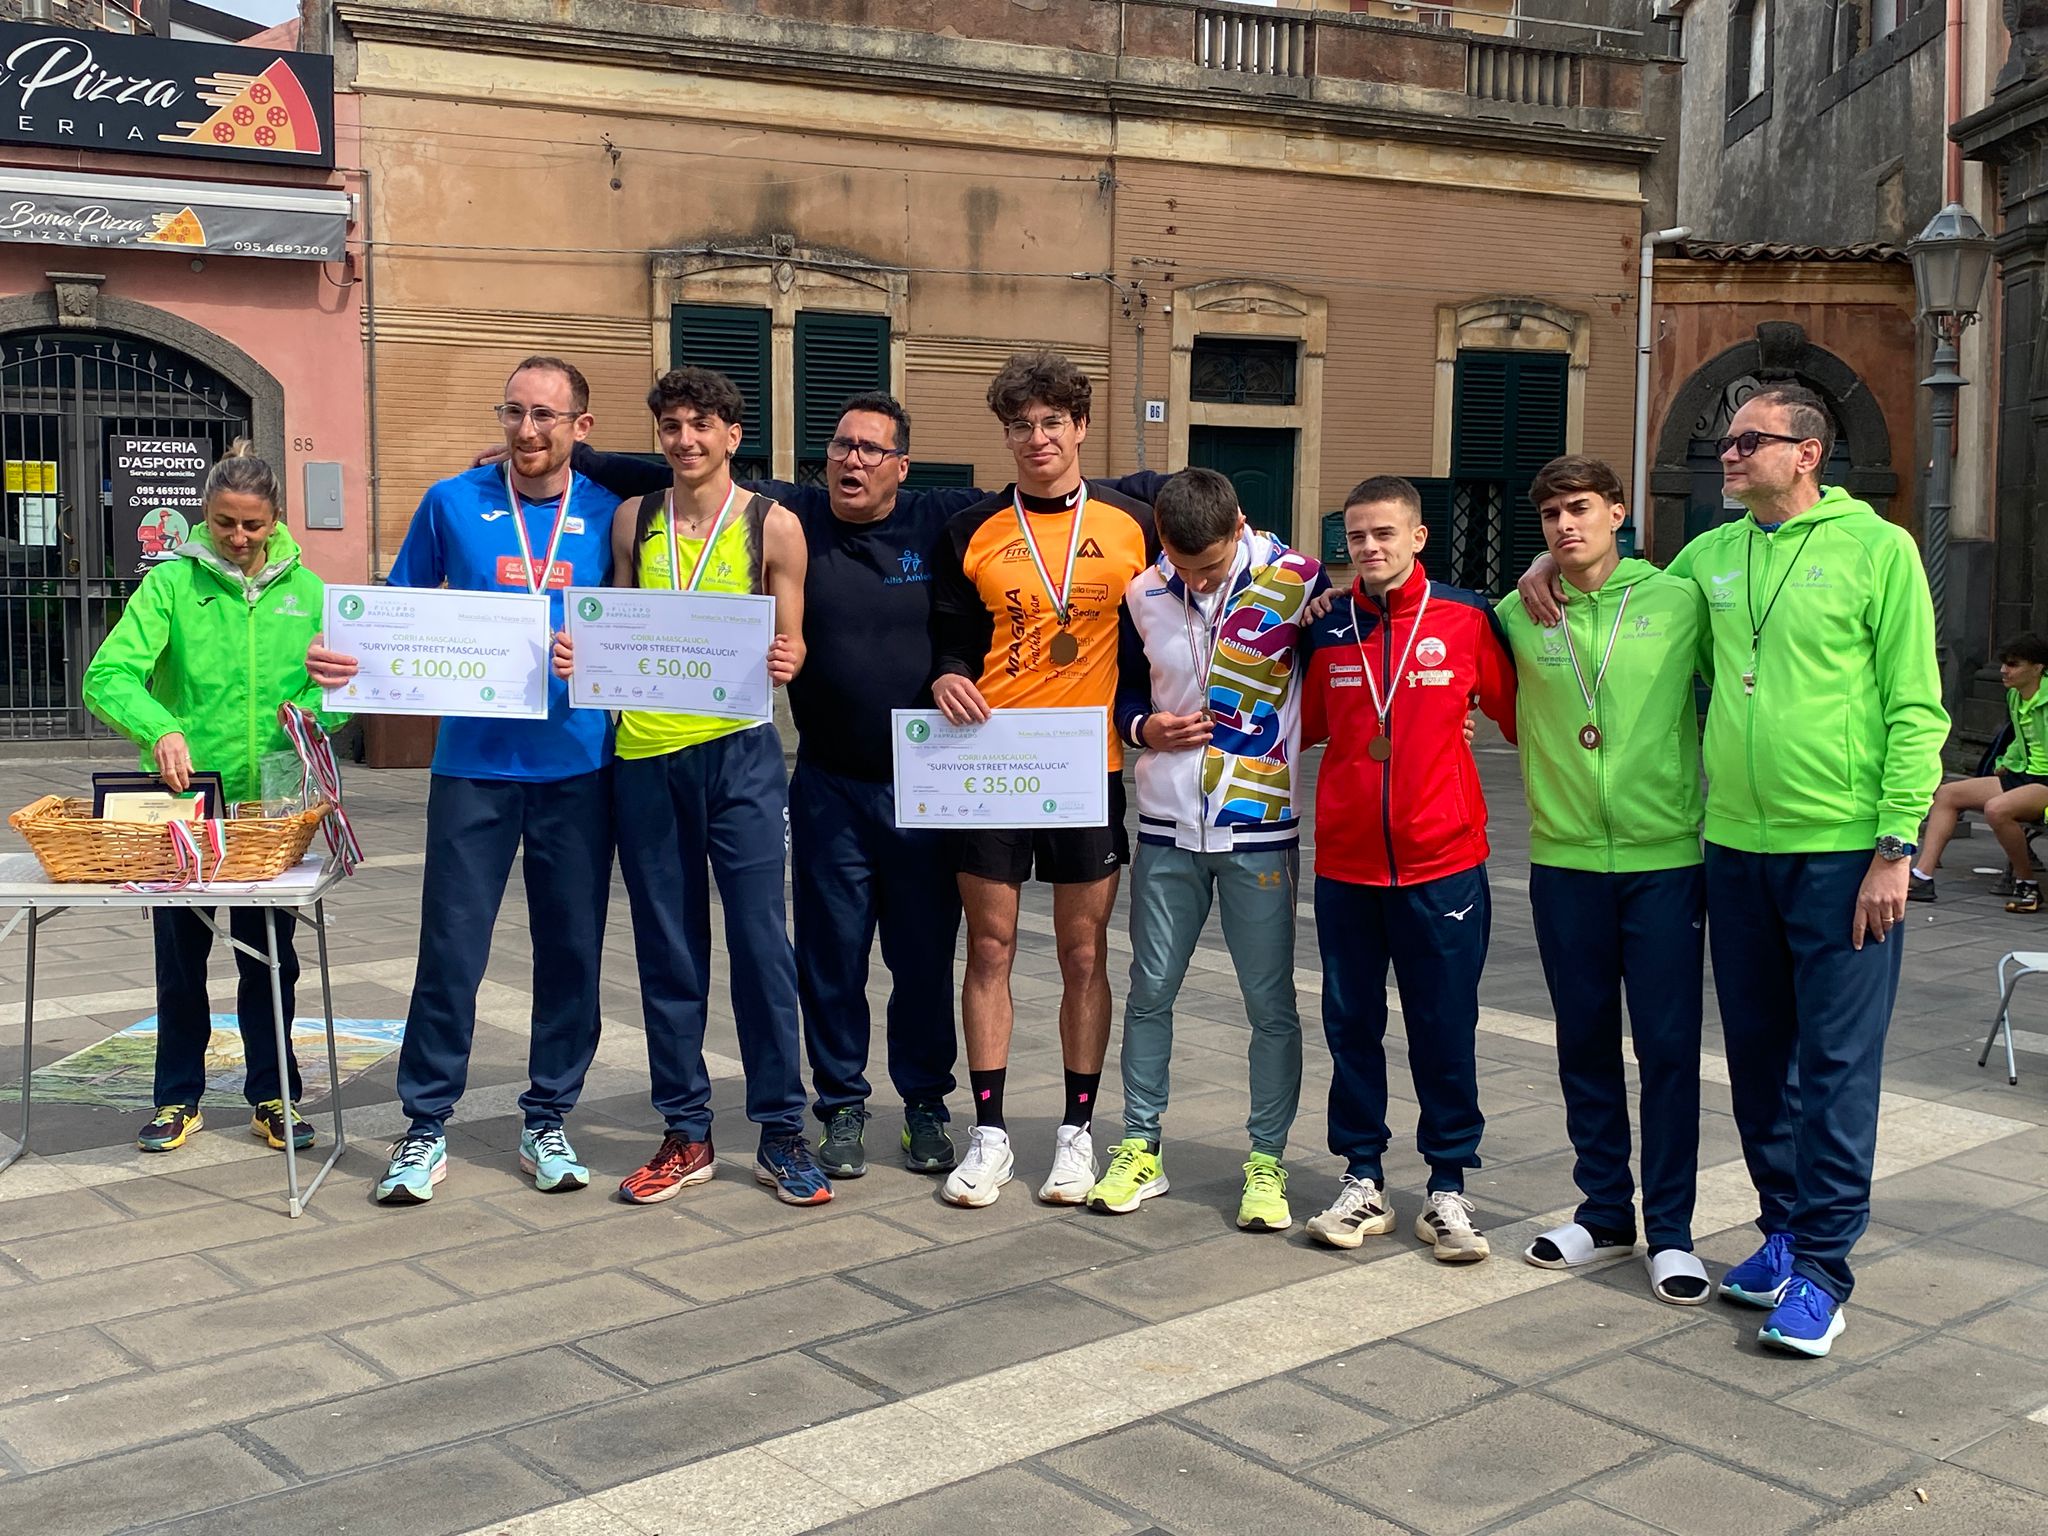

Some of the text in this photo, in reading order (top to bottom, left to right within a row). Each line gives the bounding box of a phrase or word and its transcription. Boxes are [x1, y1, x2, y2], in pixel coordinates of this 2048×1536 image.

[6, 37, 184, 110] Pizza
[0, 201, 146, 232] Bona Pizza
[14, 230, 126, 244] PIZZERIA
[234, 241, 328, 255] 095.4693708
[1150, 405, 1160, 418] 86
[126, 441, 197, 454] PIZZERIA
[294, 437, 313, 451] 88
[119, 456, 205, 469] D'ASPORTO
[136, 487, 196, 495] 095 4693708
[141, 498, 159, 506] 348
[161, 498, 178, 506] 184
[1022, 594, 1041, 620] Team
[392, 633, 416, 641] CORRI
[426, 635, 476, 644] MASCALUCIA
[631, 633, 655, 641] CORRI
[662, 636, 709, 645] MASCALUCIA
[1005, 588, 1026, 678] MAGMA
[412, 645, 444, 654] STREET
[650, 644, 679, 653] STREET
[390, 658, 486, 681] € 100,00
[638, 657, 711, 680] € 50,00
[976, 763, 1007, 771] STREET
[963, 776, 1041, 796] € 35,00
